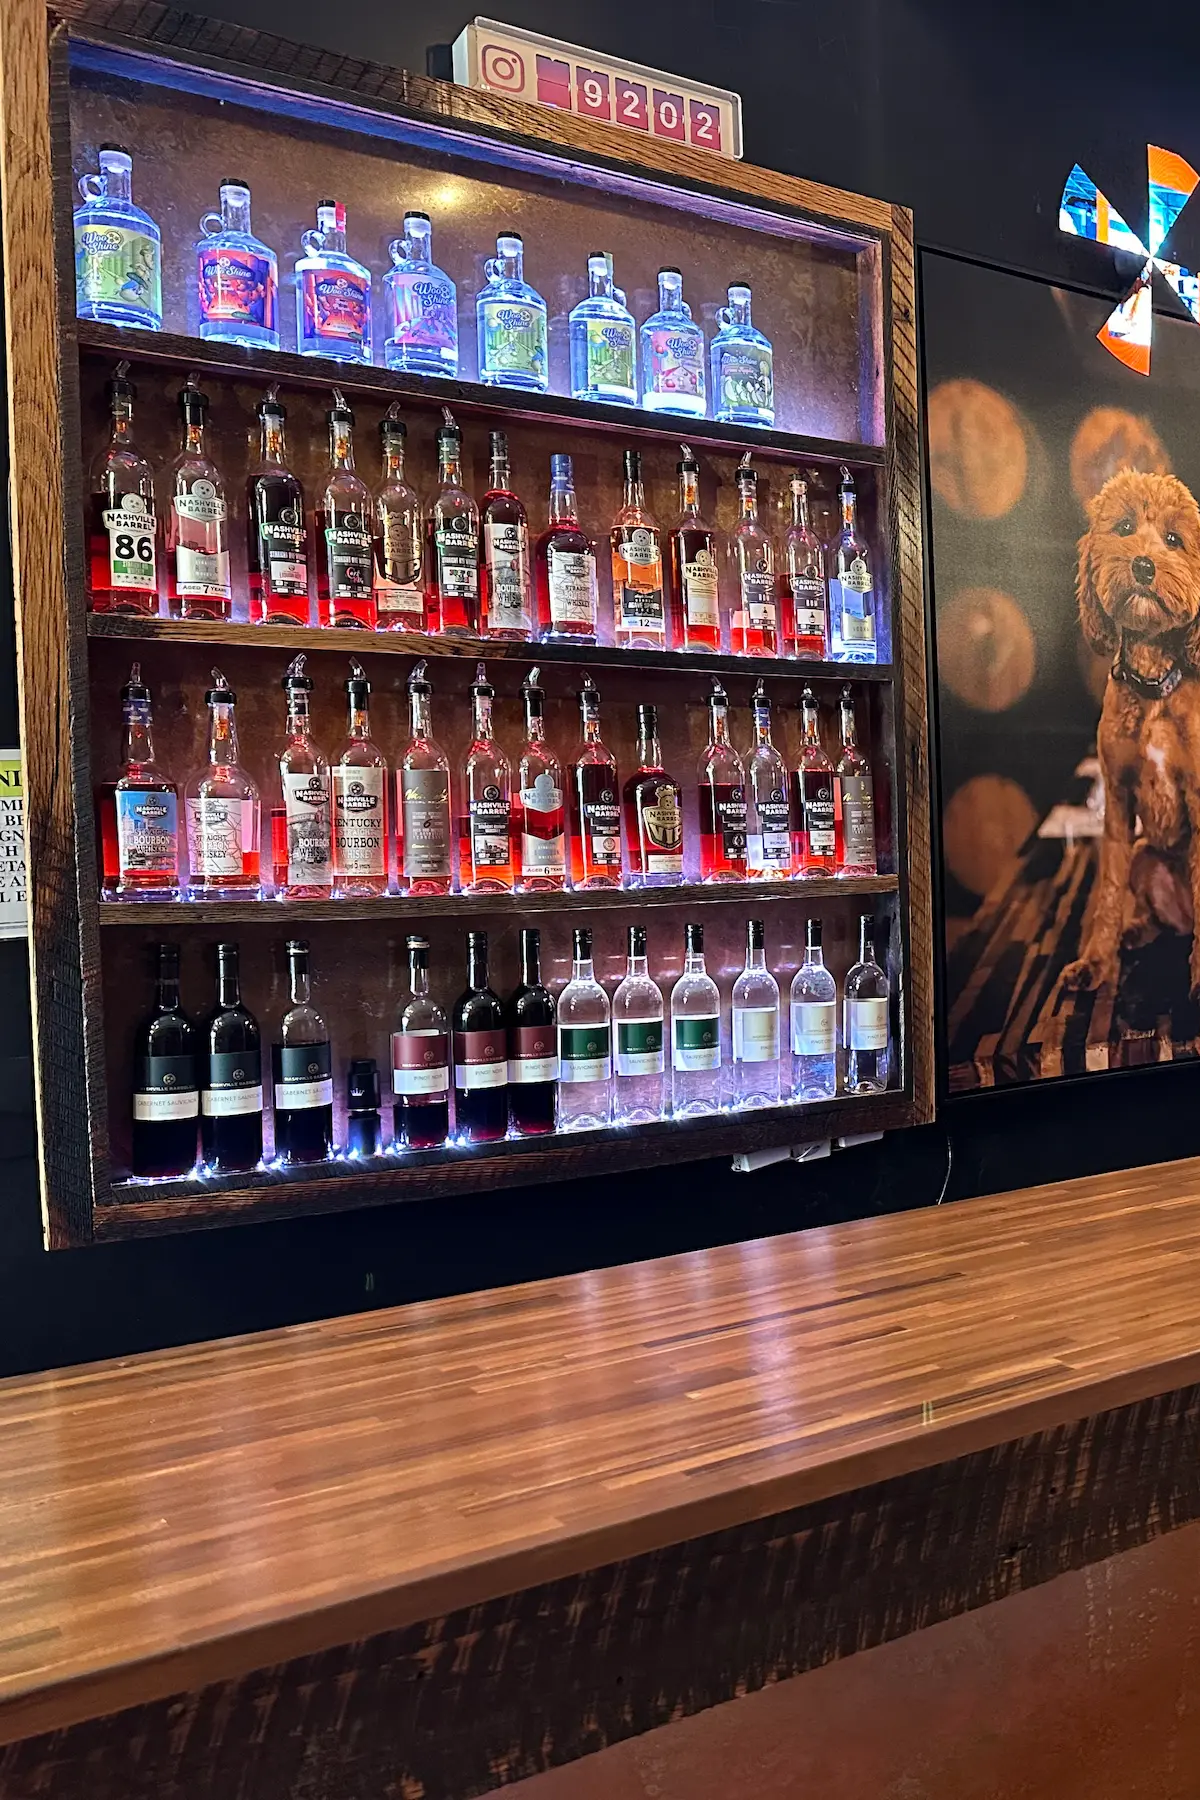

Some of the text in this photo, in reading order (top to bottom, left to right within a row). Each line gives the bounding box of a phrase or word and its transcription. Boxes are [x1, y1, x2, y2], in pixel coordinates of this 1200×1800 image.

[583, 78, 713, 141] 9202
[82, 231, 107, 245] Woo
[90, 240, 120, 255] Shine
[204, 264, 252, 279] Woo Shine
[319, 283, 364, 301] Woo Shine
[413, 281, 441, 295] Woo
[423, 294, 450, 308] Shine
[497, 309, 521, 321] Woo
[504, 318, 530, 330] Shine
[666, 337, 690, 349] Woo
[674, 346, 697, 359] Shine
[179, 499, 226, 513] NASHVILLE
[188, 506, 222, 516] BARREL
[107, 513, 155, 528] NASHVILLE
[116, 520, 152, 531] BARREL
[265, 525, 307, 539] NASHVILLE
[273, 531, 305, 542] BARREL
[328, 530, 373, 544] NASHVILLE
[337, 538, 369, 548] BARREL
[437, 532, 479, 545] NASHVILLE
[445, 539, 476, 549] BARREL
[115, 534, 153, 562] 86
[685, 566, 719, 577] NASHVILLE
[692, 571, 717, 580] BARREL
[202, 584, 210, 594] 7
[639, 619, 650, 627] 12
[295, 789, 330, 799] NASHVILLE
[337, 796, 376, 805] NASHVILLE
[805, 801, 835, 811] NASHVILLE
[135, 805, 168, 814] NASHVILLE
[469, 802, 510, 812] NASHVILLE
[586, 804, 621, 814] NASHVILLE
[719, 802, 747, 812] NASHVILLE
[758, 802, 790, 812] NASHVILLE
[765, 808, 789, 816] BARREL
[334, 818, 382, 828] KENTUCKY
[133, 835, 170, 844] BOURBON
[335, 837, 380, 848] BOURBON
[136, 845, 169, 854] WHISKEY
[354, 860, 360, 869] 5
[543, 866, 551, 875] 6
